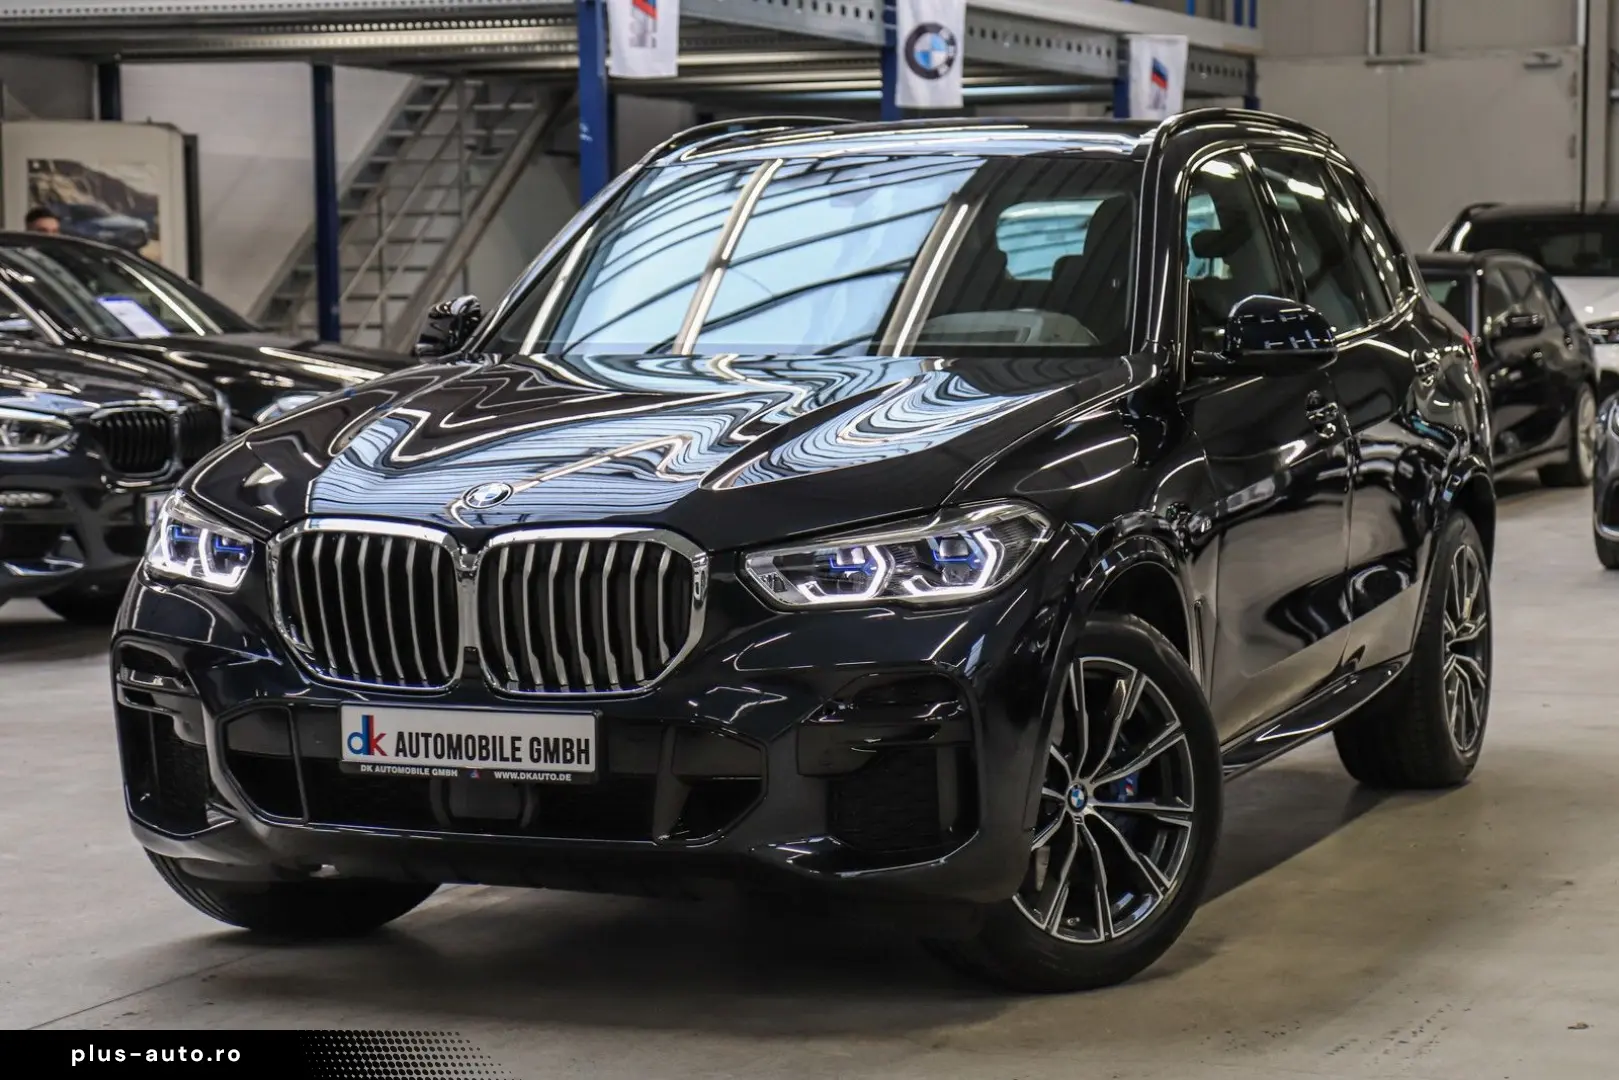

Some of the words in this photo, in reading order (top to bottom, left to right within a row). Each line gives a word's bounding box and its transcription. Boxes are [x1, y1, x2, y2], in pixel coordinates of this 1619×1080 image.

[347, 715, 388, 756] dk
[395, 731, 522, 763] AUTOMOBILE
[529, 737, 591, 765] GMBH
[360, 764, 373, 773] DK
[375, 765, 430, 776] AUTOMOBILE
[432, 768, 458, 778] GMBH
[494, 771, 572, 782] WWW.DKAUTO.DE
